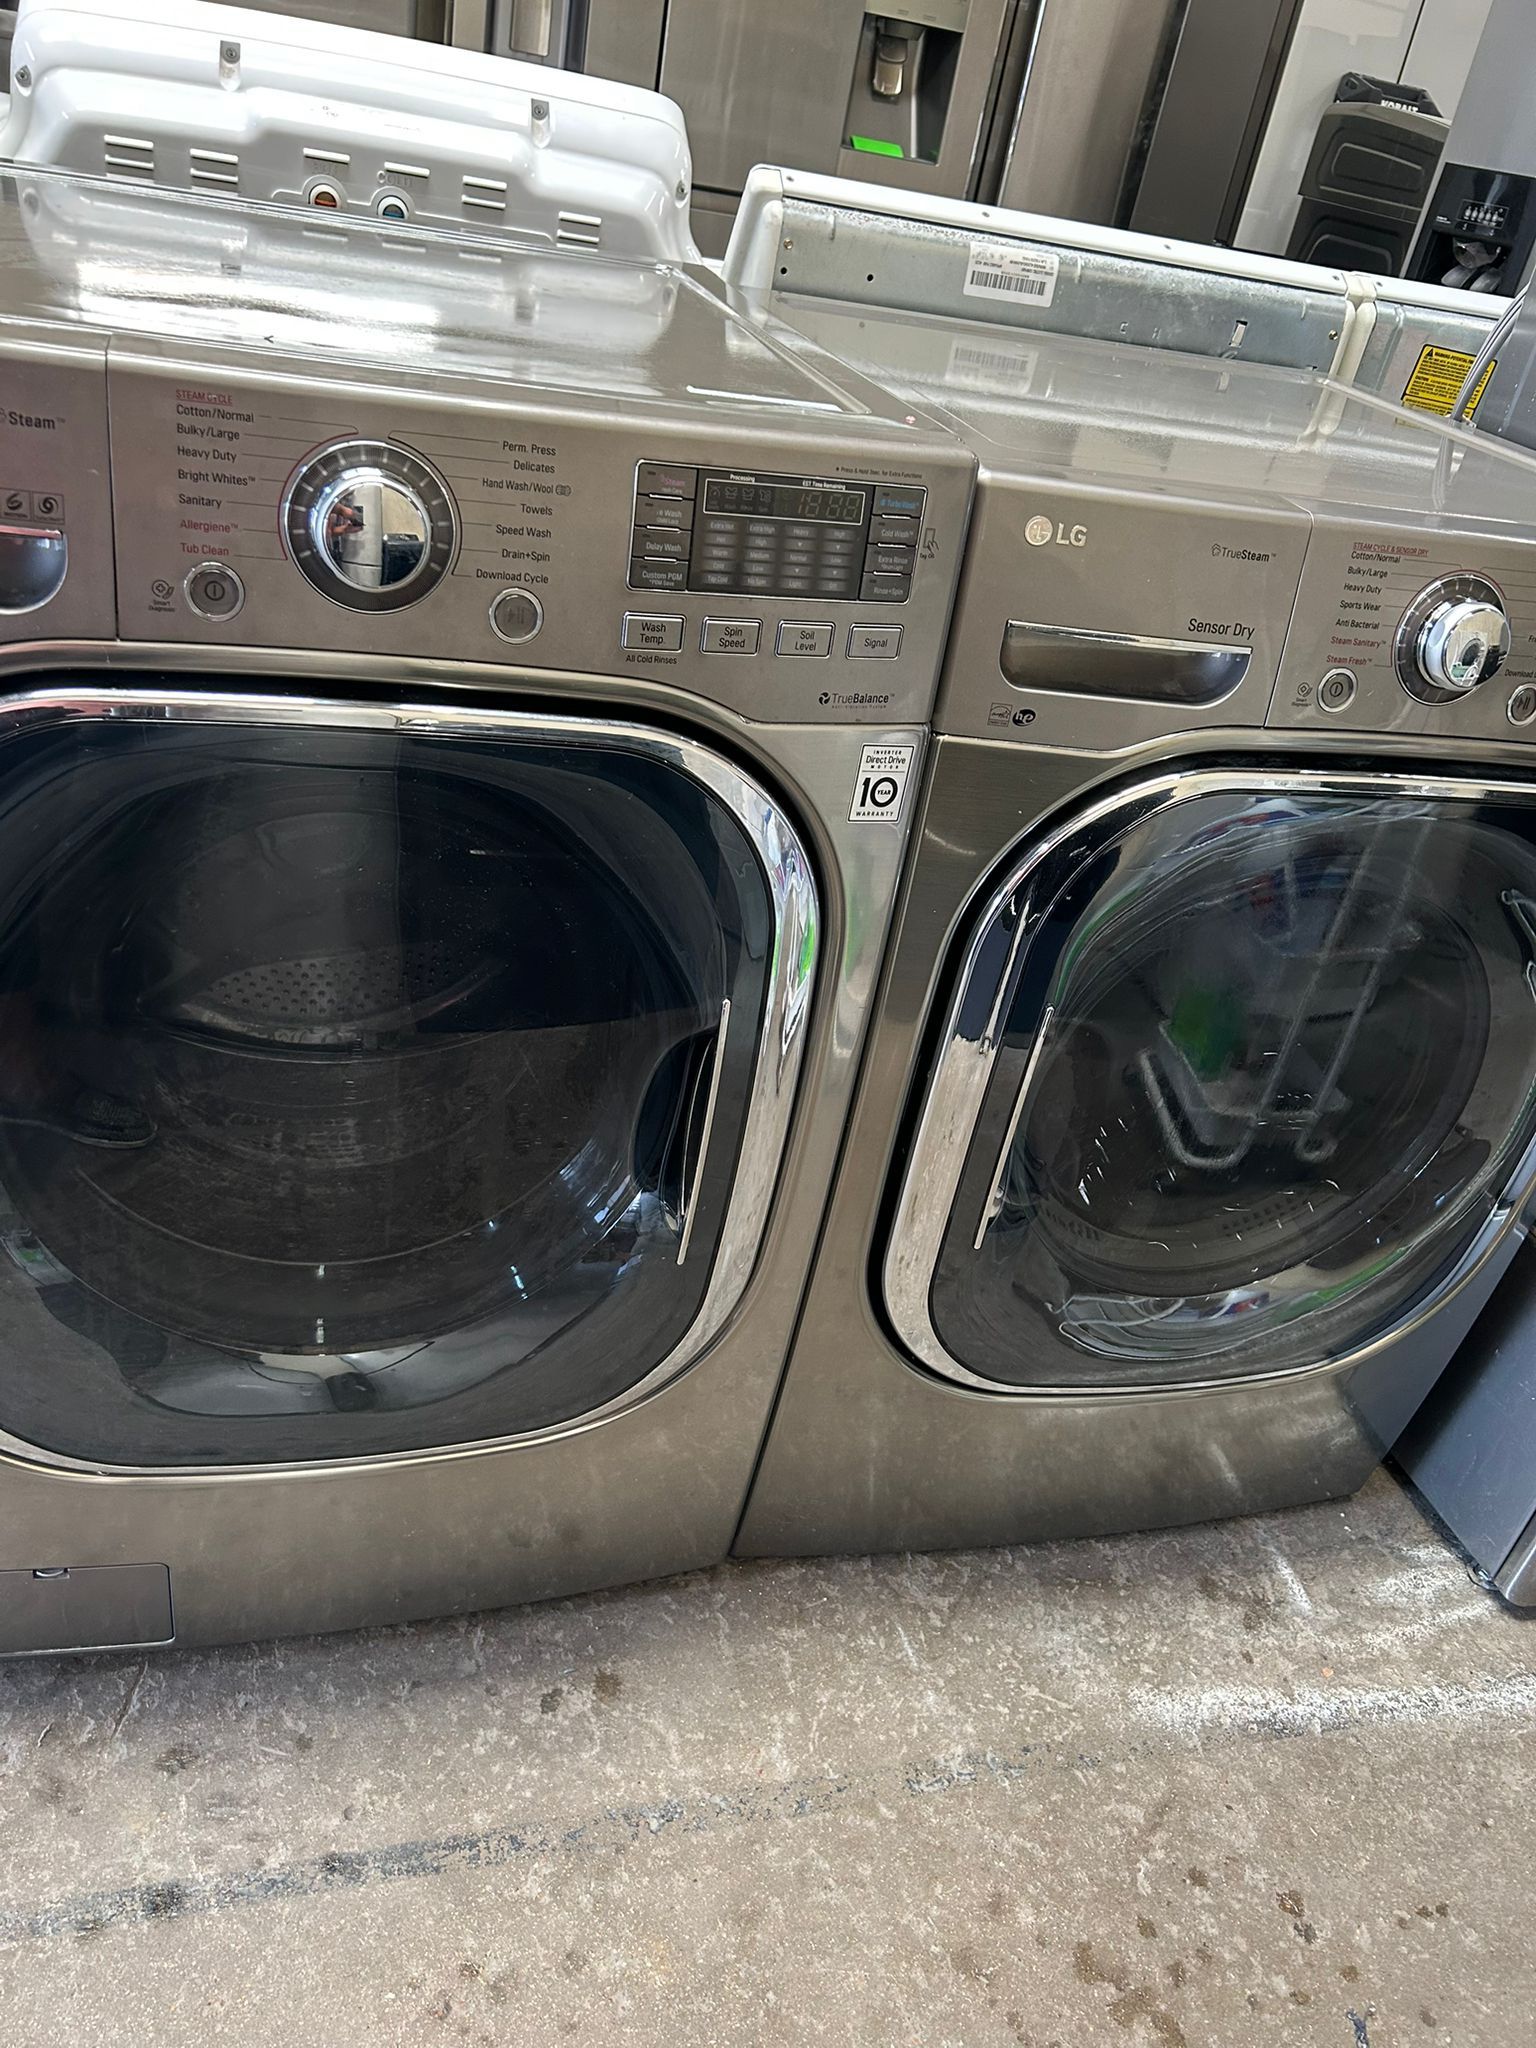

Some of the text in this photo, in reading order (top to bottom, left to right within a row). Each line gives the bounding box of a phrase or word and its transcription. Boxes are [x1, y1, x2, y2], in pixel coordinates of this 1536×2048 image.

[176, 389, 205, 402] STEAM
[176, 404, 254, 422] Cotton/Normal
[176, 423, 240, 442] Bulky/Large
[502, 440, 557, 456] Perm. Press
[177, 446, 237, 464] Heavy Duty
[513, 460, 556, 474] Delicates
[178, 468, 209, 483] Bright
[482, 478, 554, 494] Hand Wash/Wool
[178, 494, 222, 510] Sanitary
[520, 503, 553, 516] Towels
[496, 524, 552, 538] Speed Wash
[1056, 522, 1088, 548] LG
[180, 542, 230, 556] Tub Clean
[664, 543, 682, 552] Wash
[1354, 542, 1372, 552] STEAM
[1372, 544, 1391, 554] CYCLE
[502, 548, 551, 563] Drain+Spin
[1351, 550, 1401, 564] Cotton/Normal
[476, 568, 549, 585] Download Cycle
[642, 570, 666, 580] Custom
[1348, 566, 1388, 579] Bulky/Large
[1343, 583, 1382, 595] Heavy Duty
[1339, 600, 1382, 612] Sports Wear
[641, 622, 666, 633] Wash
[1187, 618, 1256, 640] Sensor Dry
[1335, 618, 1380, 630] Anti Bacterial
[724, 626, 743, 638] Spin
[800, 630, 816, 640] Soil
[640, 634, 666, 645] Temp.
[718, 637, 746, 648] Speed
[864, 637, 888, 649] Signal
[1330, 636, 1353, 646] Steam
[794, 641, 817, 652] Level
[626, 654, 678, 665] All Cold Rinses
[1326, 654, 1349, 665] Steam
[866, 755, 906, 764] Direct Drive
[860, 776, 898, 808] 10
